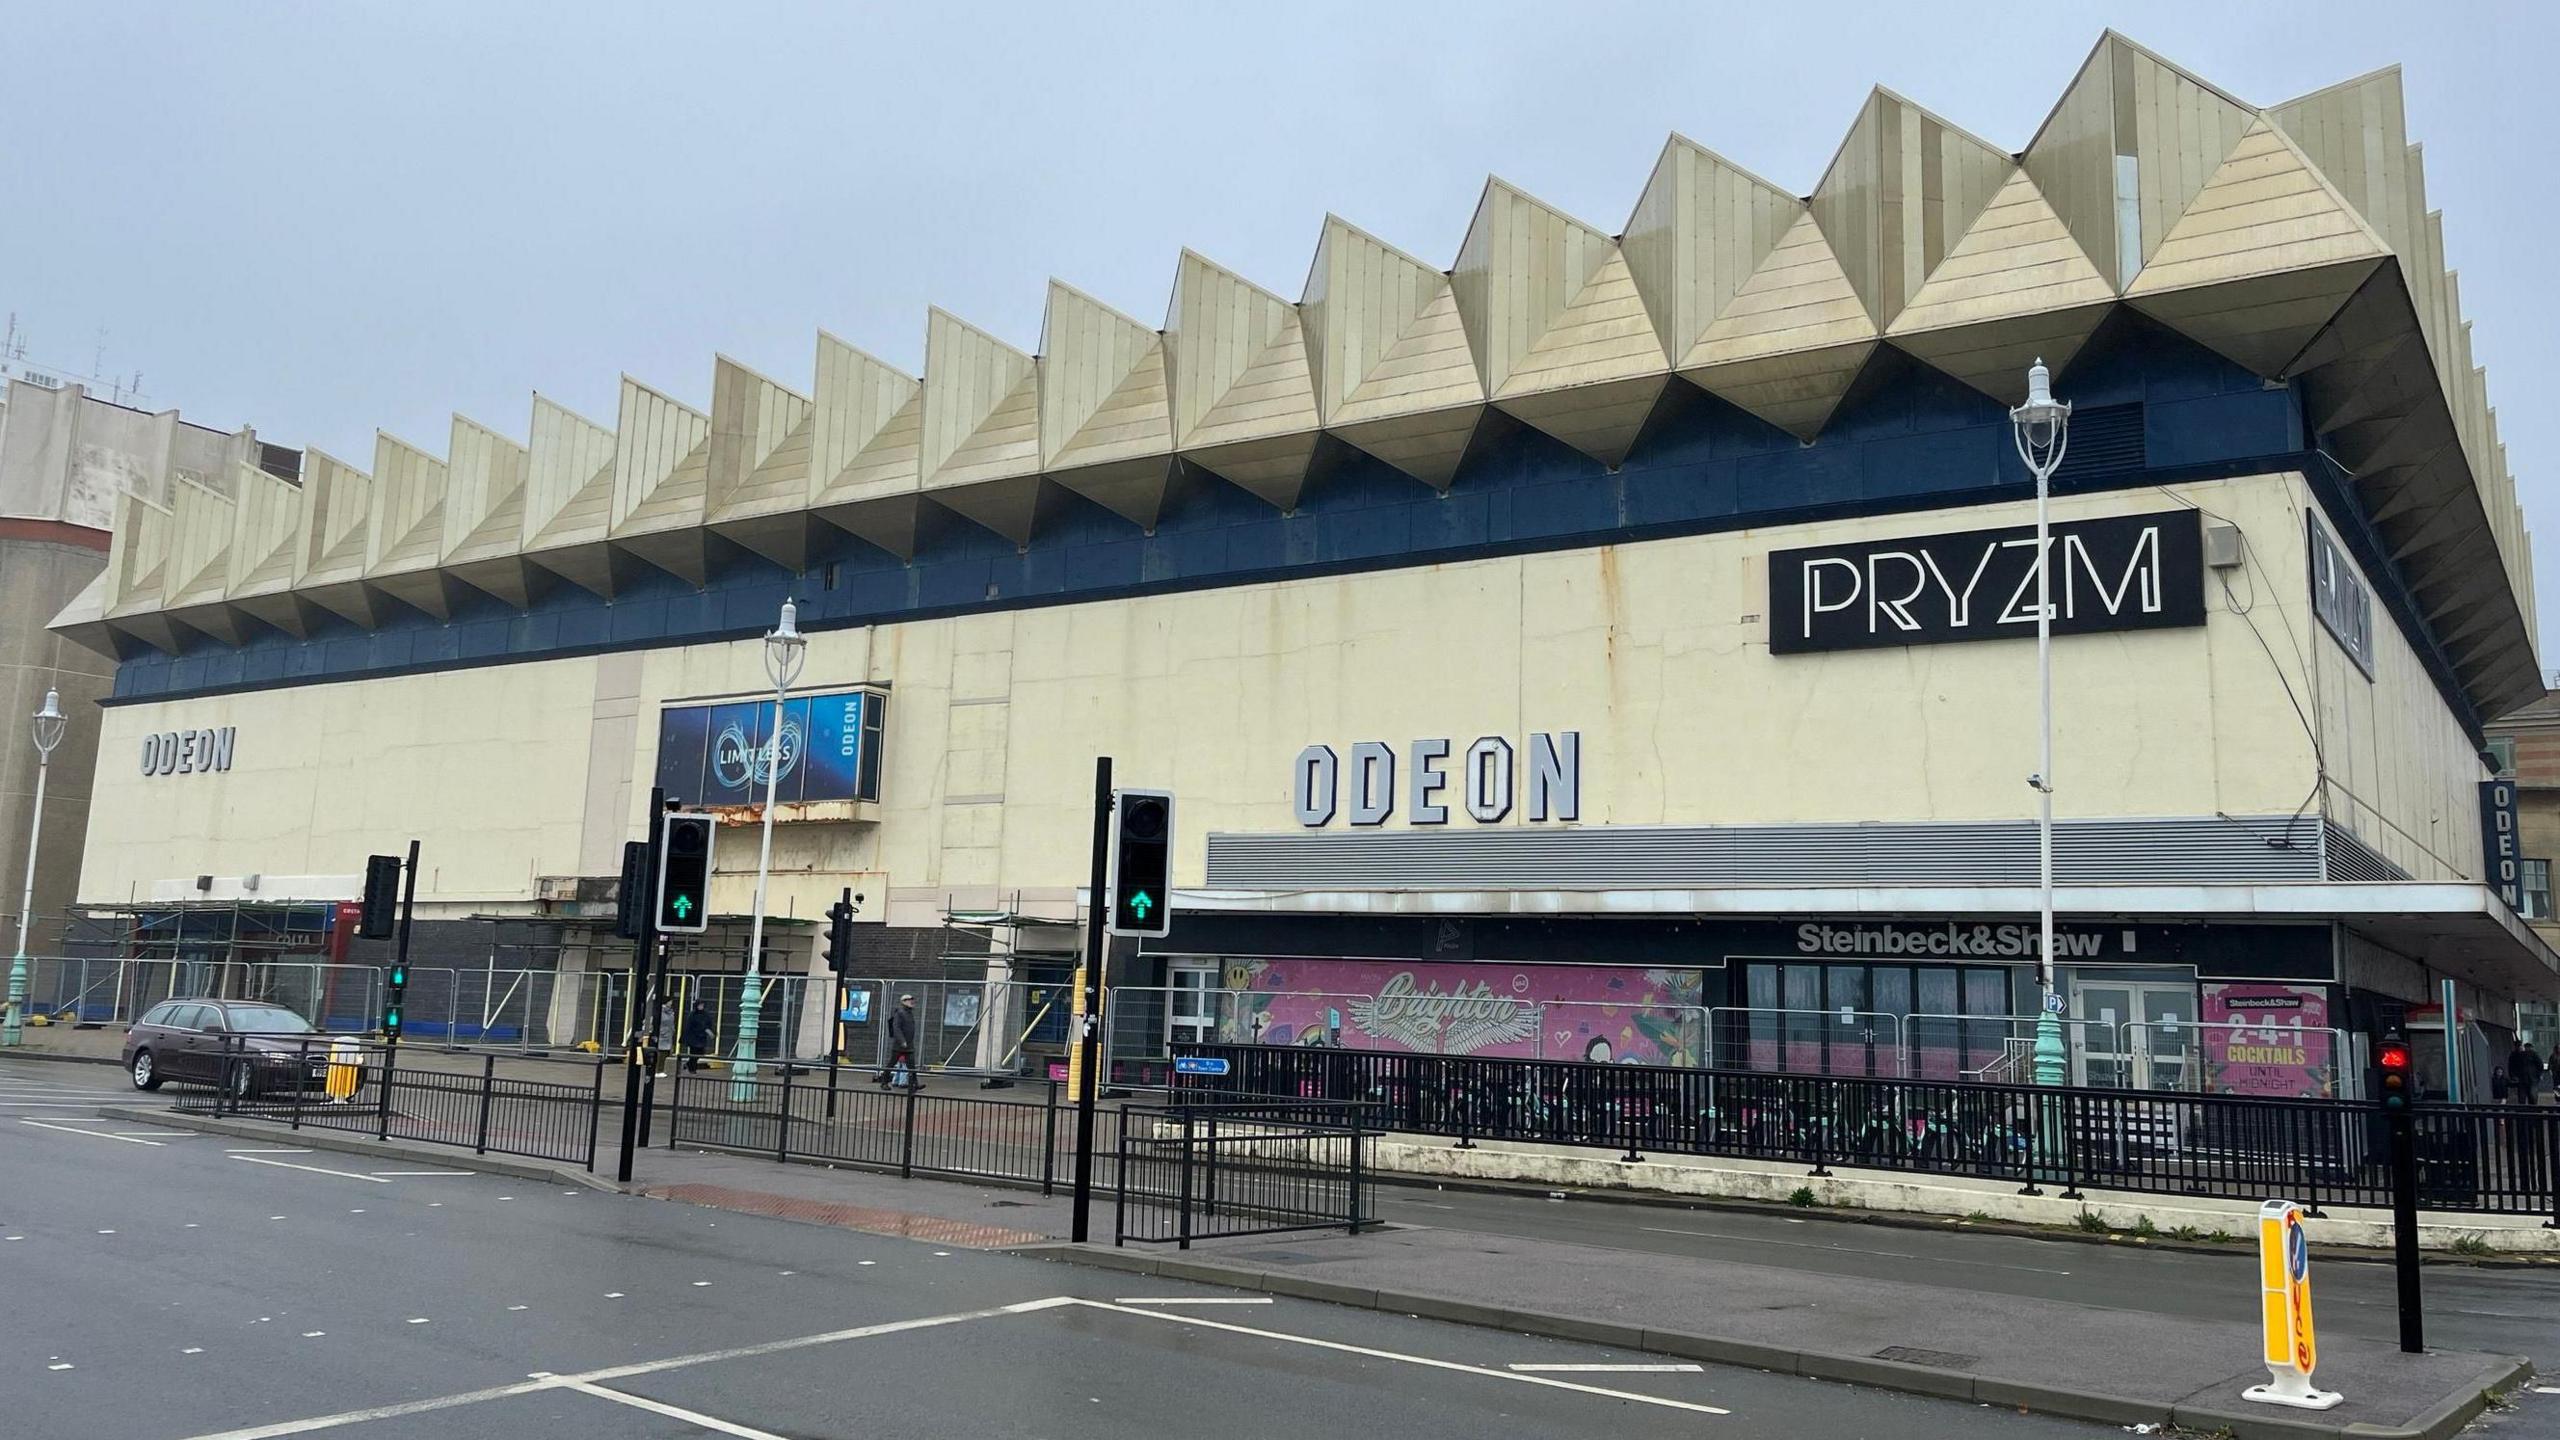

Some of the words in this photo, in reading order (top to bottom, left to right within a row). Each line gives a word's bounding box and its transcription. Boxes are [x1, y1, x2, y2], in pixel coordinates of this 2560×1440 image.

[1803, 526, 2162, 639] PRYZM
[140, 726, 236, 776] ODEON
[841, 701, 857, 756] ODEON
[1294, 731, 1580, 827] ODEON
[2493, 785, 2517, 907] ODEON
[1797, 922, 2104, 957] Steinbeck&Shaw
[1377, 972, 1519, 1037] Brighton
[2227, 1012, 2304, 1047] 2-4-1
[2227, 1045, 2306, 1065] COCKTAILS
[2249, 1065, 2285, 1078] UNTIL
